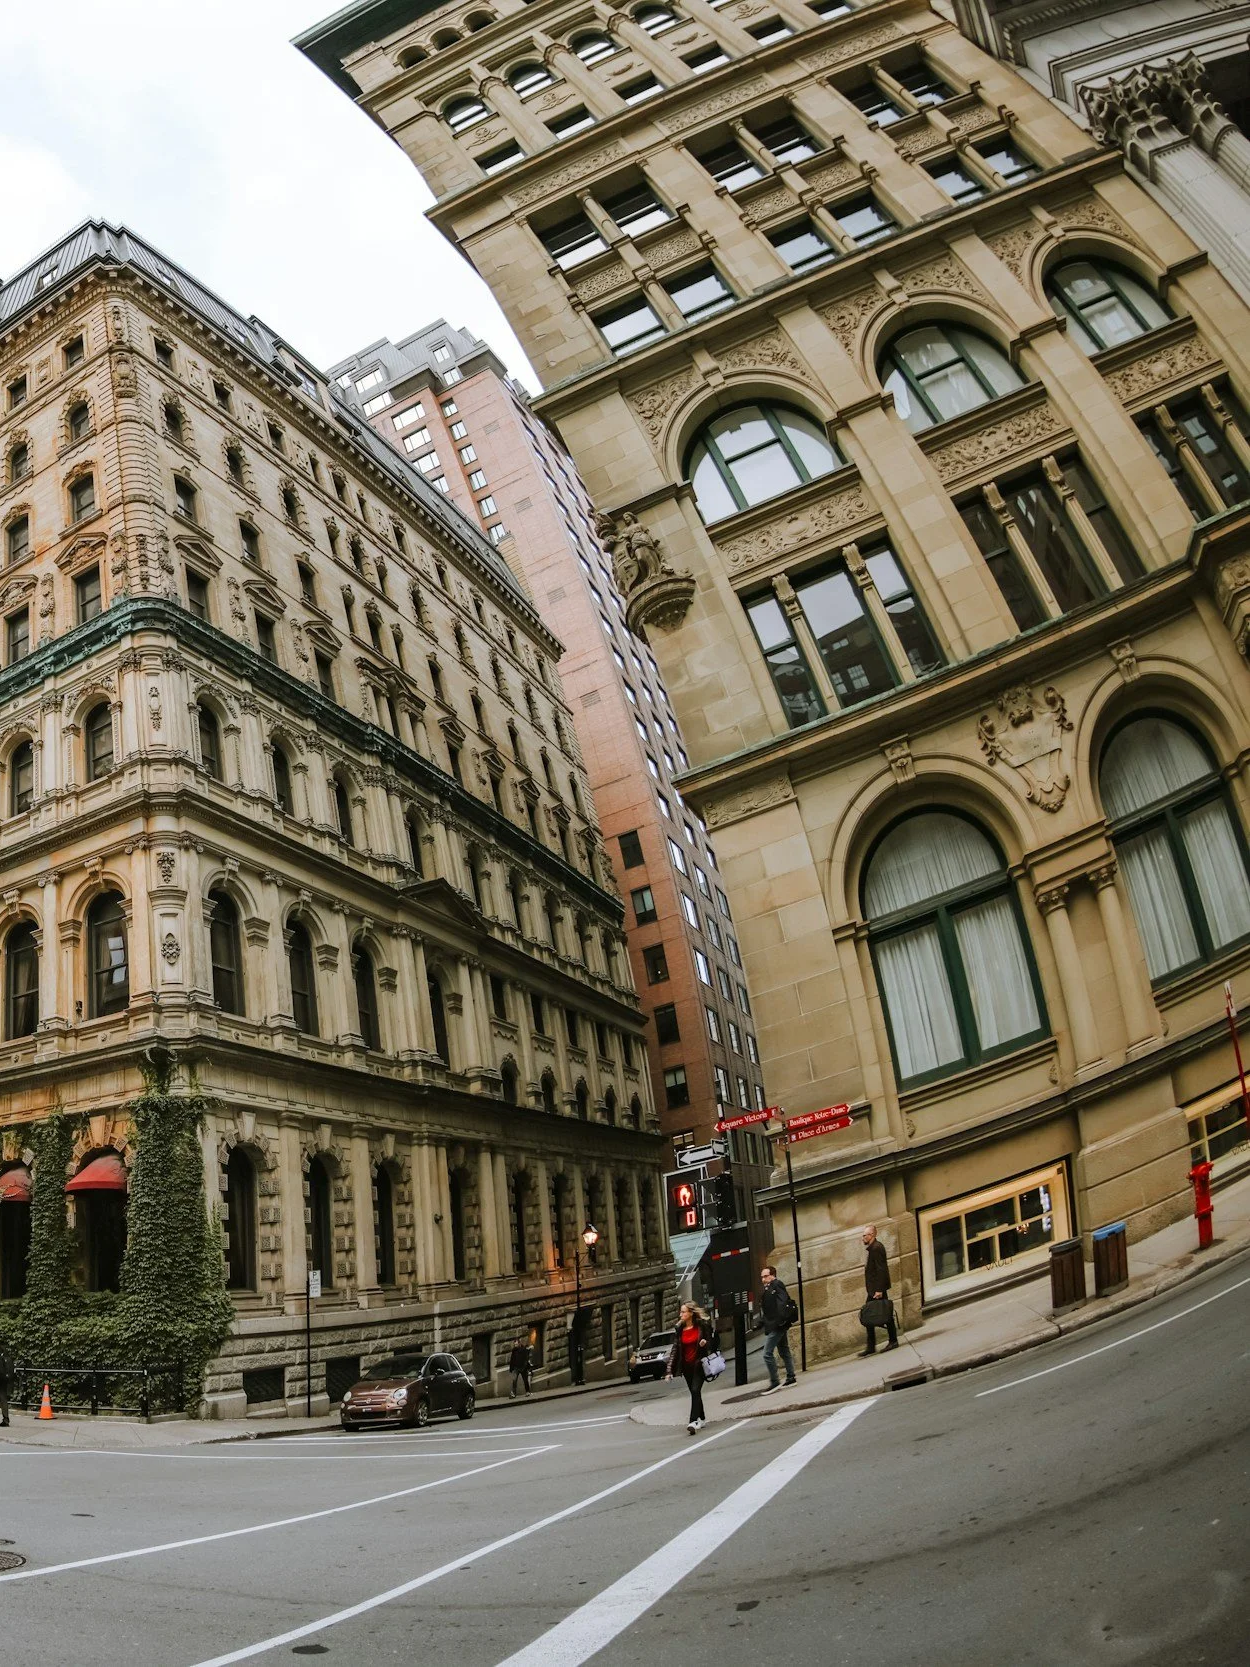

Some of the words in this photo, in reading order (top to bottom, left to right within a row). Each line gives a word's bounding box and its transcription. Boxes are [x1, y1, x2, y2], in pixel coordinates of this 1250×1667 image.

[720, 1119, 744, 1130] Square
[744, 1111, 768, 1123] Victoria
[798, 1129, 815, 1140] Place
[816, 1123, 840, 1134] d'Armes
[686, 1210, 696, 1227] 0
